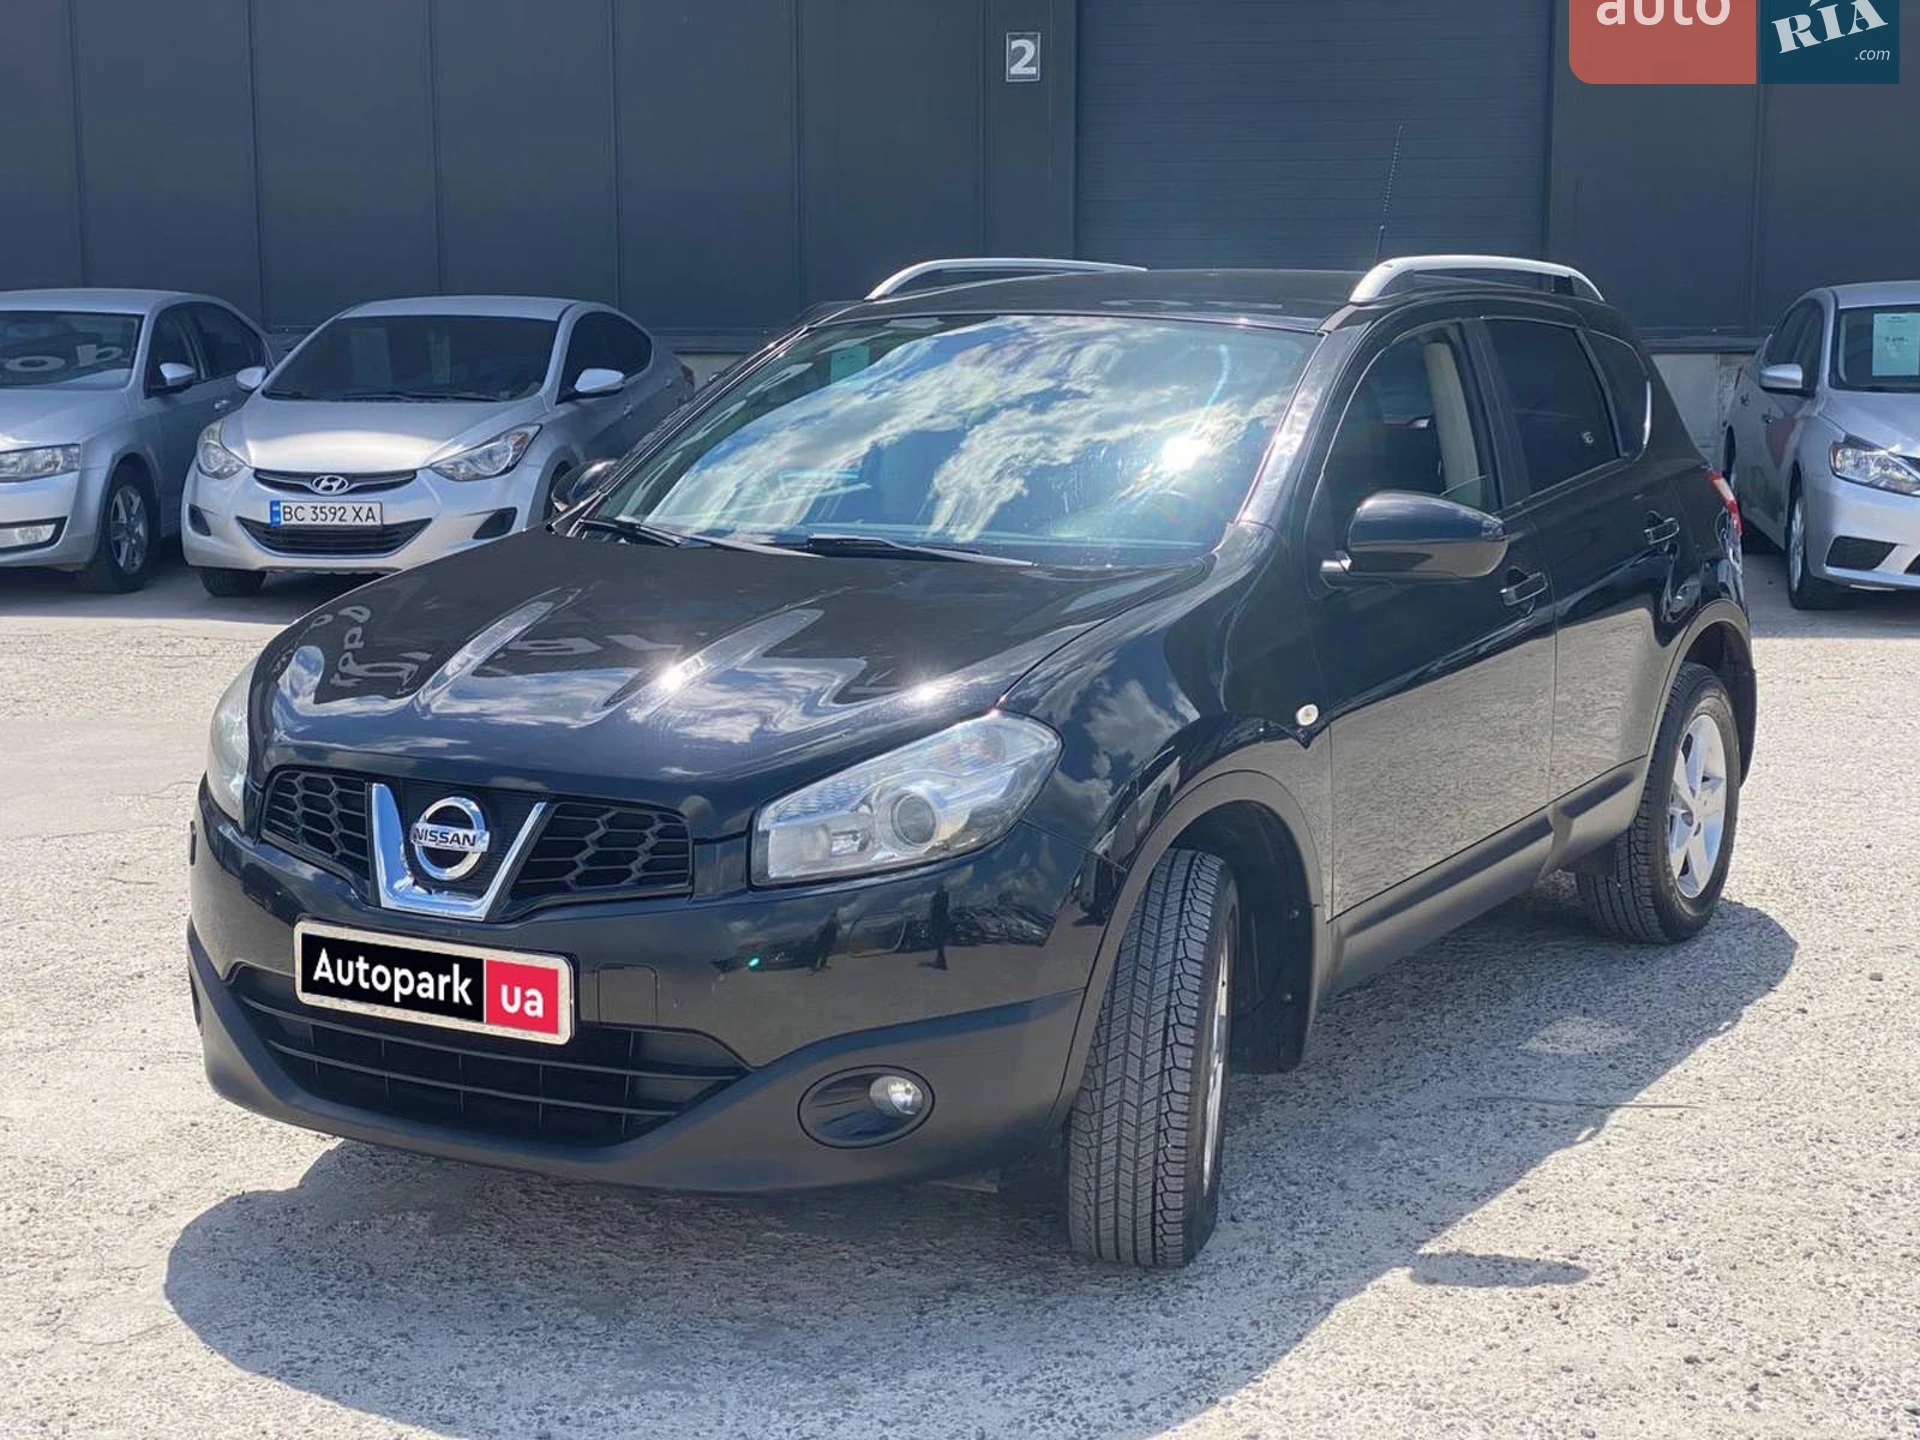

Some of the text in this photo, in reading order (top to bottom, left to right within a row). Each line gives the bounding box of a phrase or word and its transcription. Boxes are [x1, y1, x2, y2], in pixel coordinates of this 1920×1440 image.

[1010, 39, 1037, 75] 2
[282, 505, 377, 522] BC 3592 XA
[413, 827, 477, 847] NISSAN
